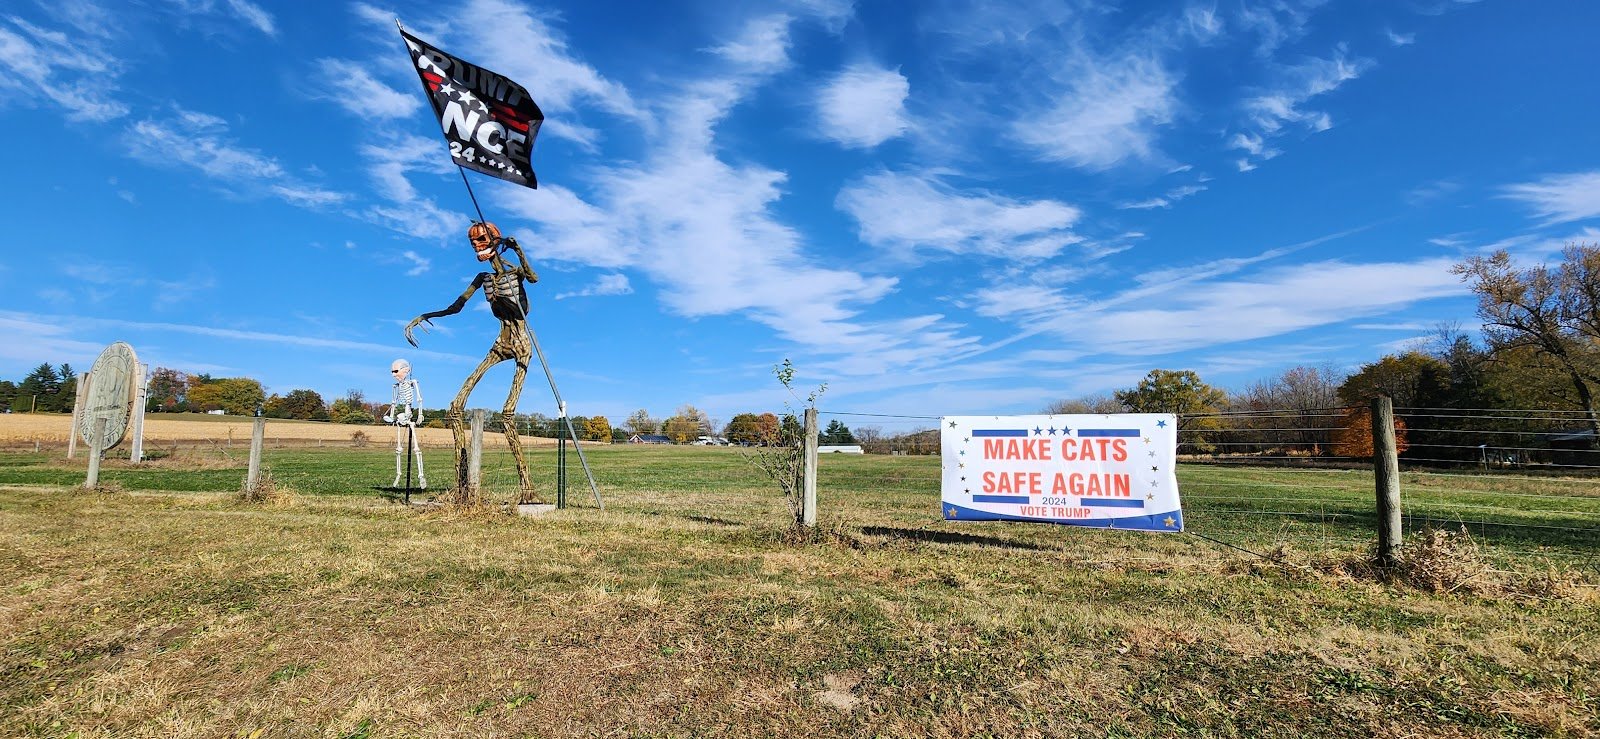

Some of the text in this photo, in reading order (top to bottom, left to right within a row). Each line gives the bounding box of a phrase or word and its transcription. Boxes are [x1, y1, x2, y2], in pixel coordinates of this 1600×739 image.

[984, 438, 1128, 462] MAKE CATS
[982, 471, 1131, 497] SAFE AGAIN
[1042, 497, 1067, 506] 2024
[1020, 506, 1091, 518] VOTE TRUMP
